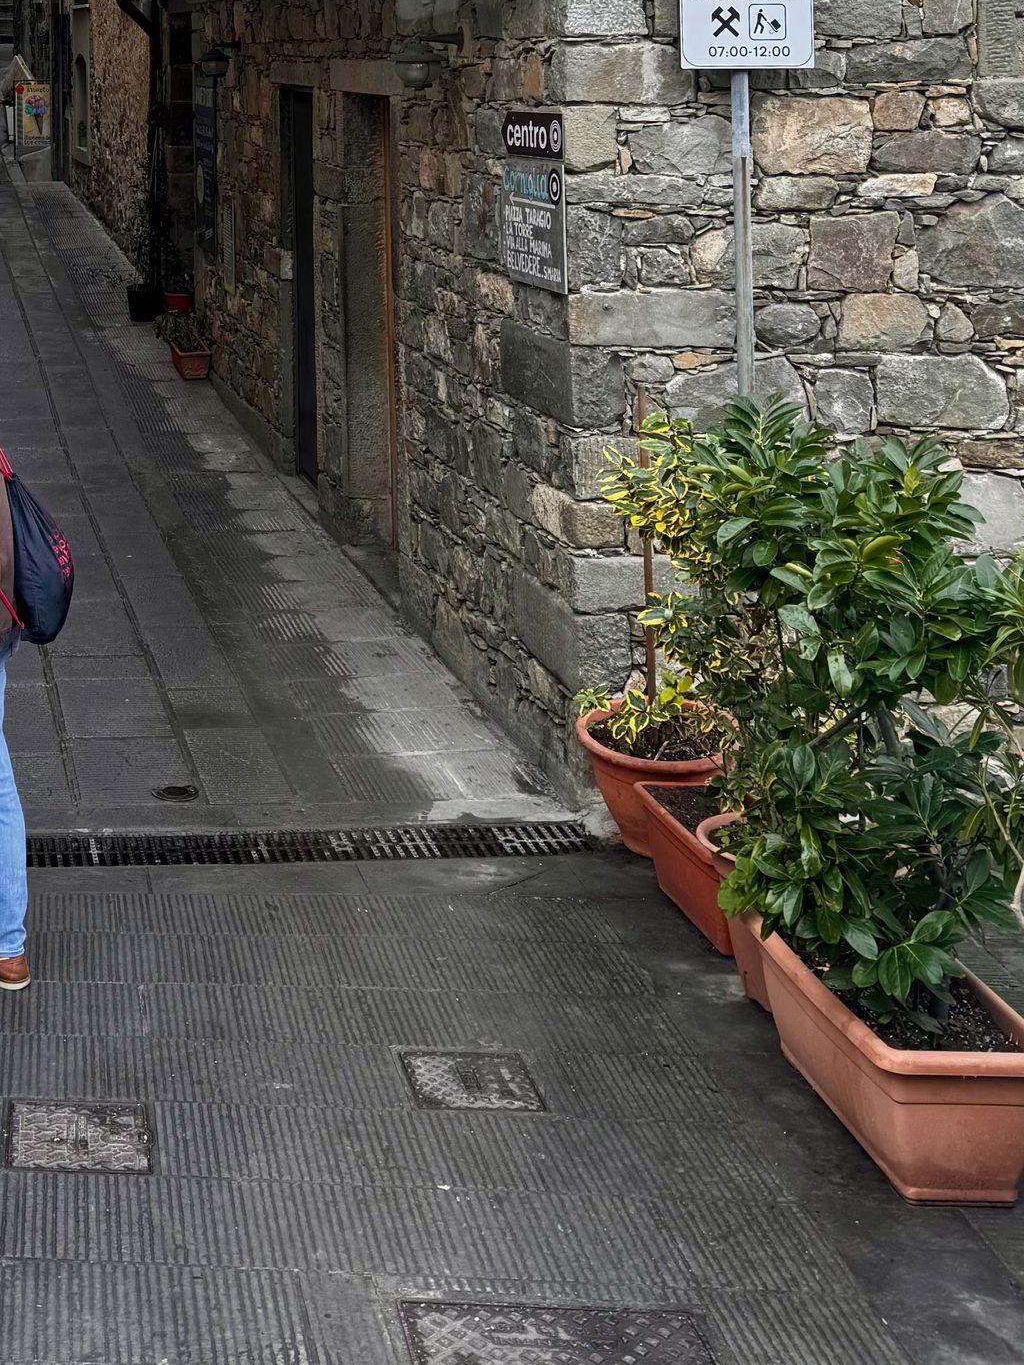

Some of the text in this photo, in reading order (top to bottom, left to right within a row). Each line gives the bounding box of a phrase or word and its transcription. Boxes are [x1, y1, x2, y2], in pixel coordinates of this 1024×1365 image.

[708, 46, 791, 57] 07:00-12:00
[507, 120, 547, 149] centro
[503, 166, 548, 201] Corniglia
[505, 205, 523, 222] PIAZZA
[506, 222, 533, 239] LA TORRE
